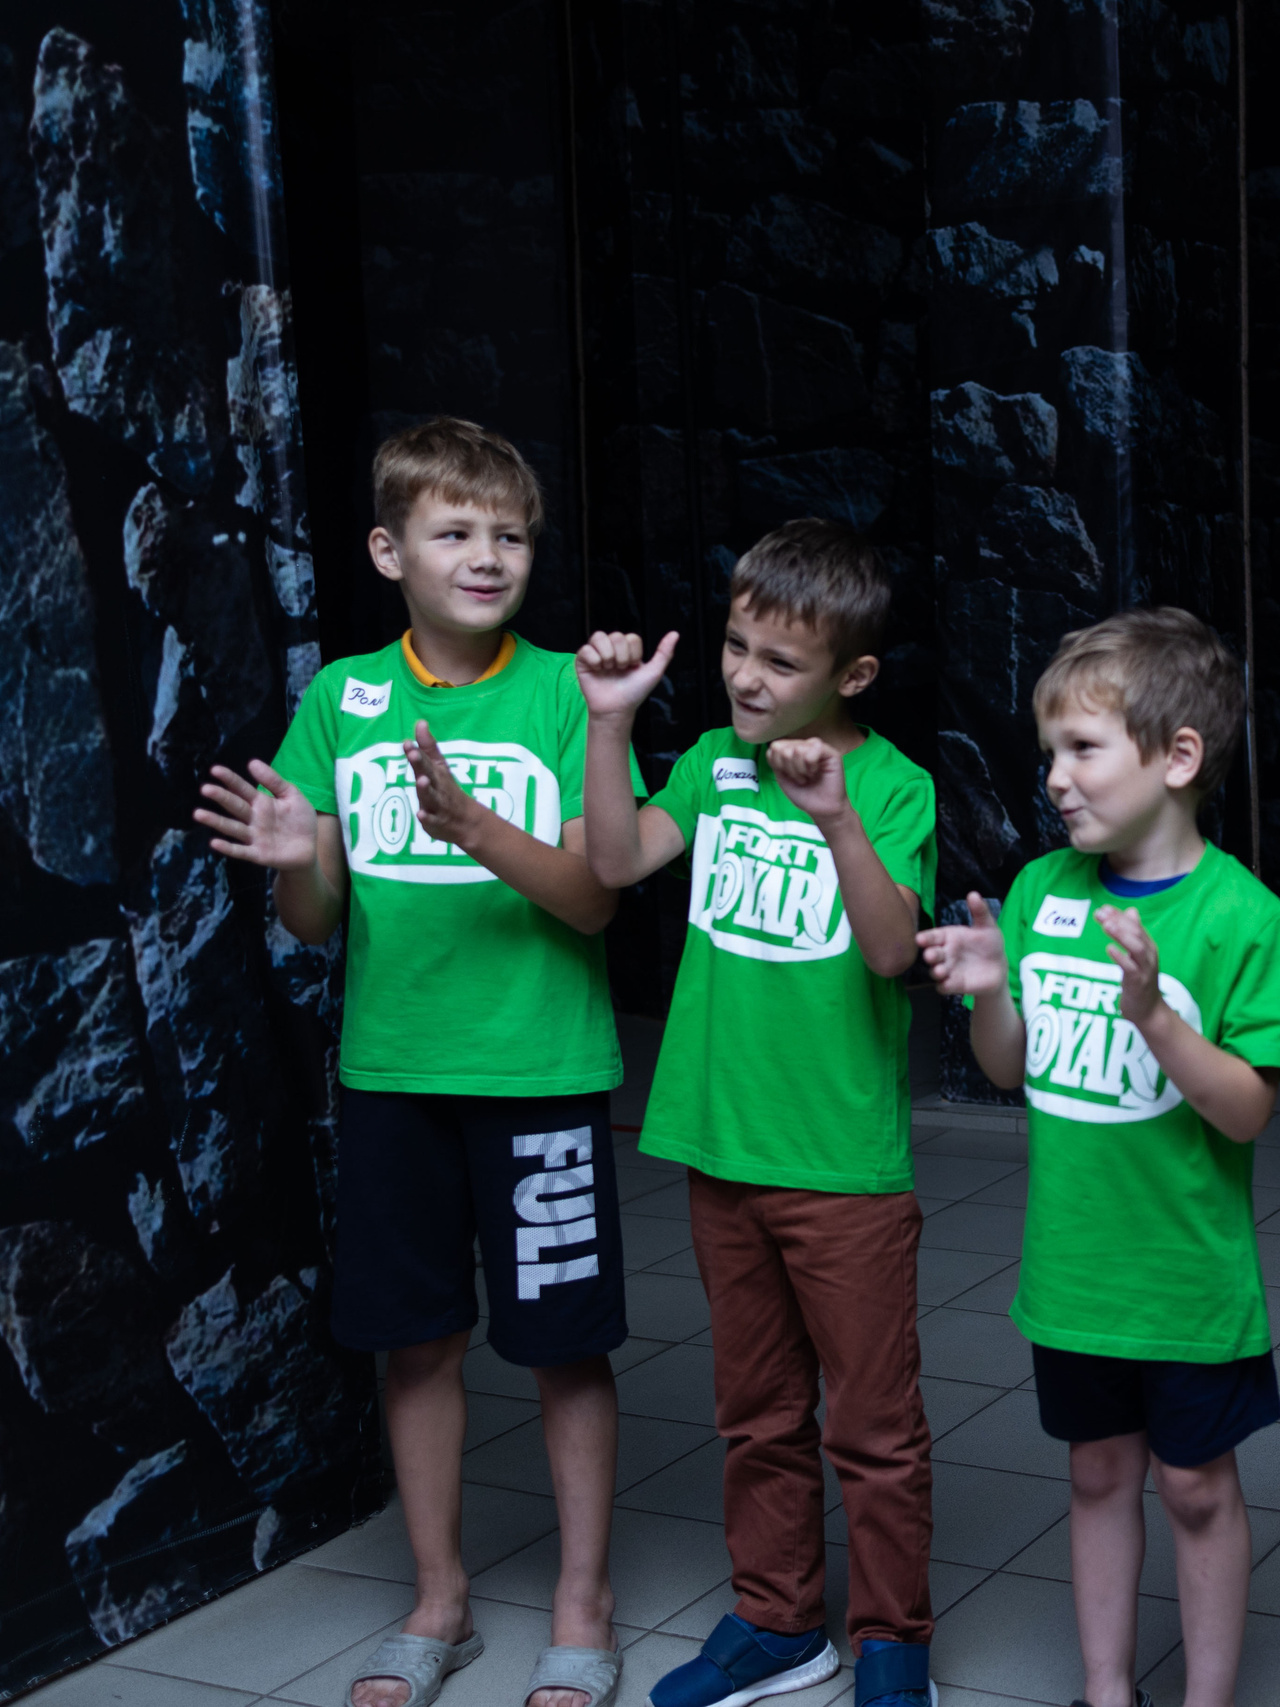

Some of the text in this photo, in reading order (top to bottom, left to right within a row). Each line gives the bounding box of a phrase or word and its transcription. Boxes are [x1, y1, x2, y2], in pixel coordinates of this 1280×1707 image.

[386, 757, 498, 785] FRT
[725, 823, 817, 866] FORT
[1041, 973, 1123, 1014] FOR
[512, 1125, 599, 1300] FULL
